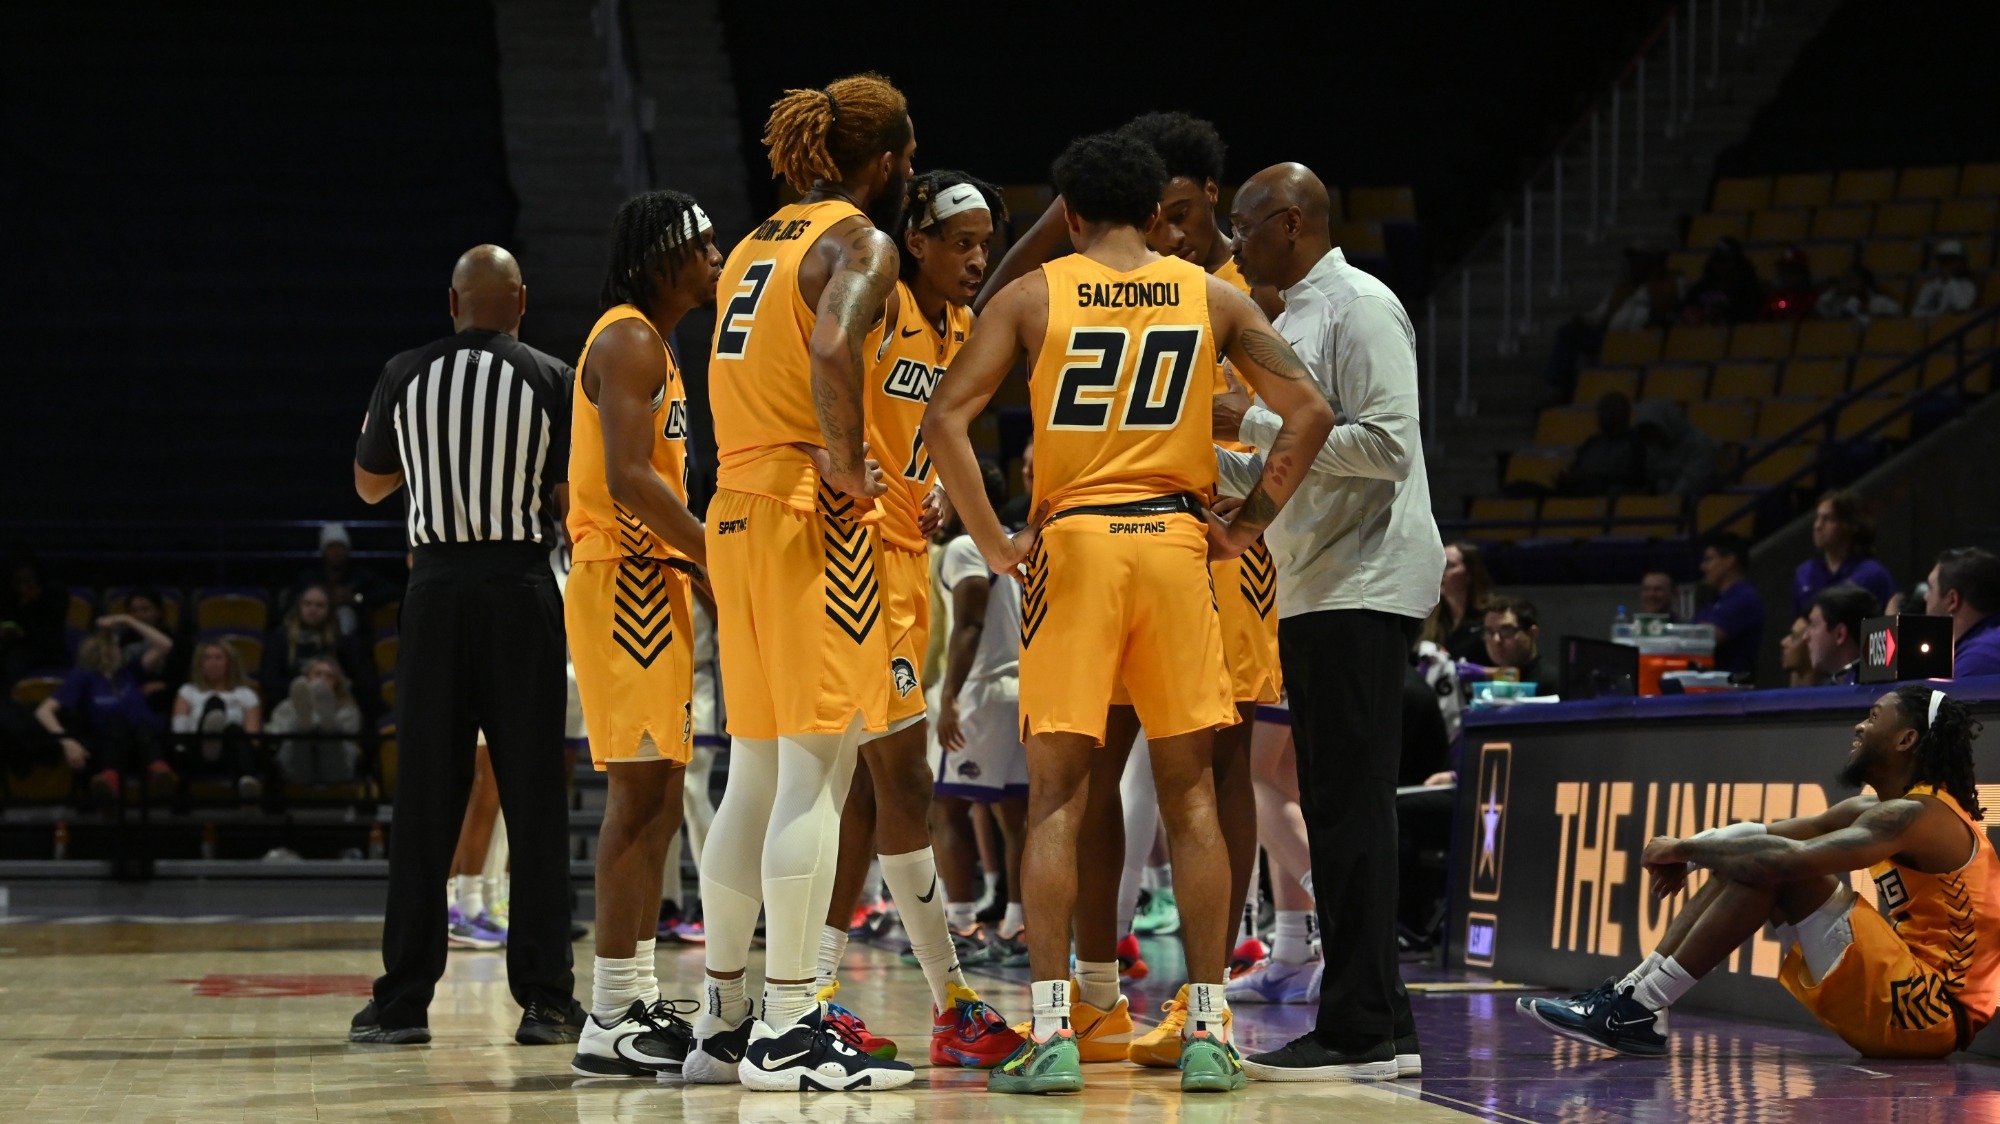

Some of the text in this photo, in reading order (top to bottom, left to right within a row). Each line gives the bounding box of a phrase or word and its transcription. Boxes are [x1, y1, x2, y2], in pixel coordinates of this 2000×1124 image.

[716, 258, 777, 360] 2
[1078, 282, 1180, 308] SAIZONOU
[882, 356, 948, 405] UN
[1046, 325, 1203, 431] 20
[663, 398, 688, 440] UN
[1109, 521, 1166, 534] SPARTANS
[1868, 629, 1887, 667] POSS
[1551, 782, 1634, 957] THE
